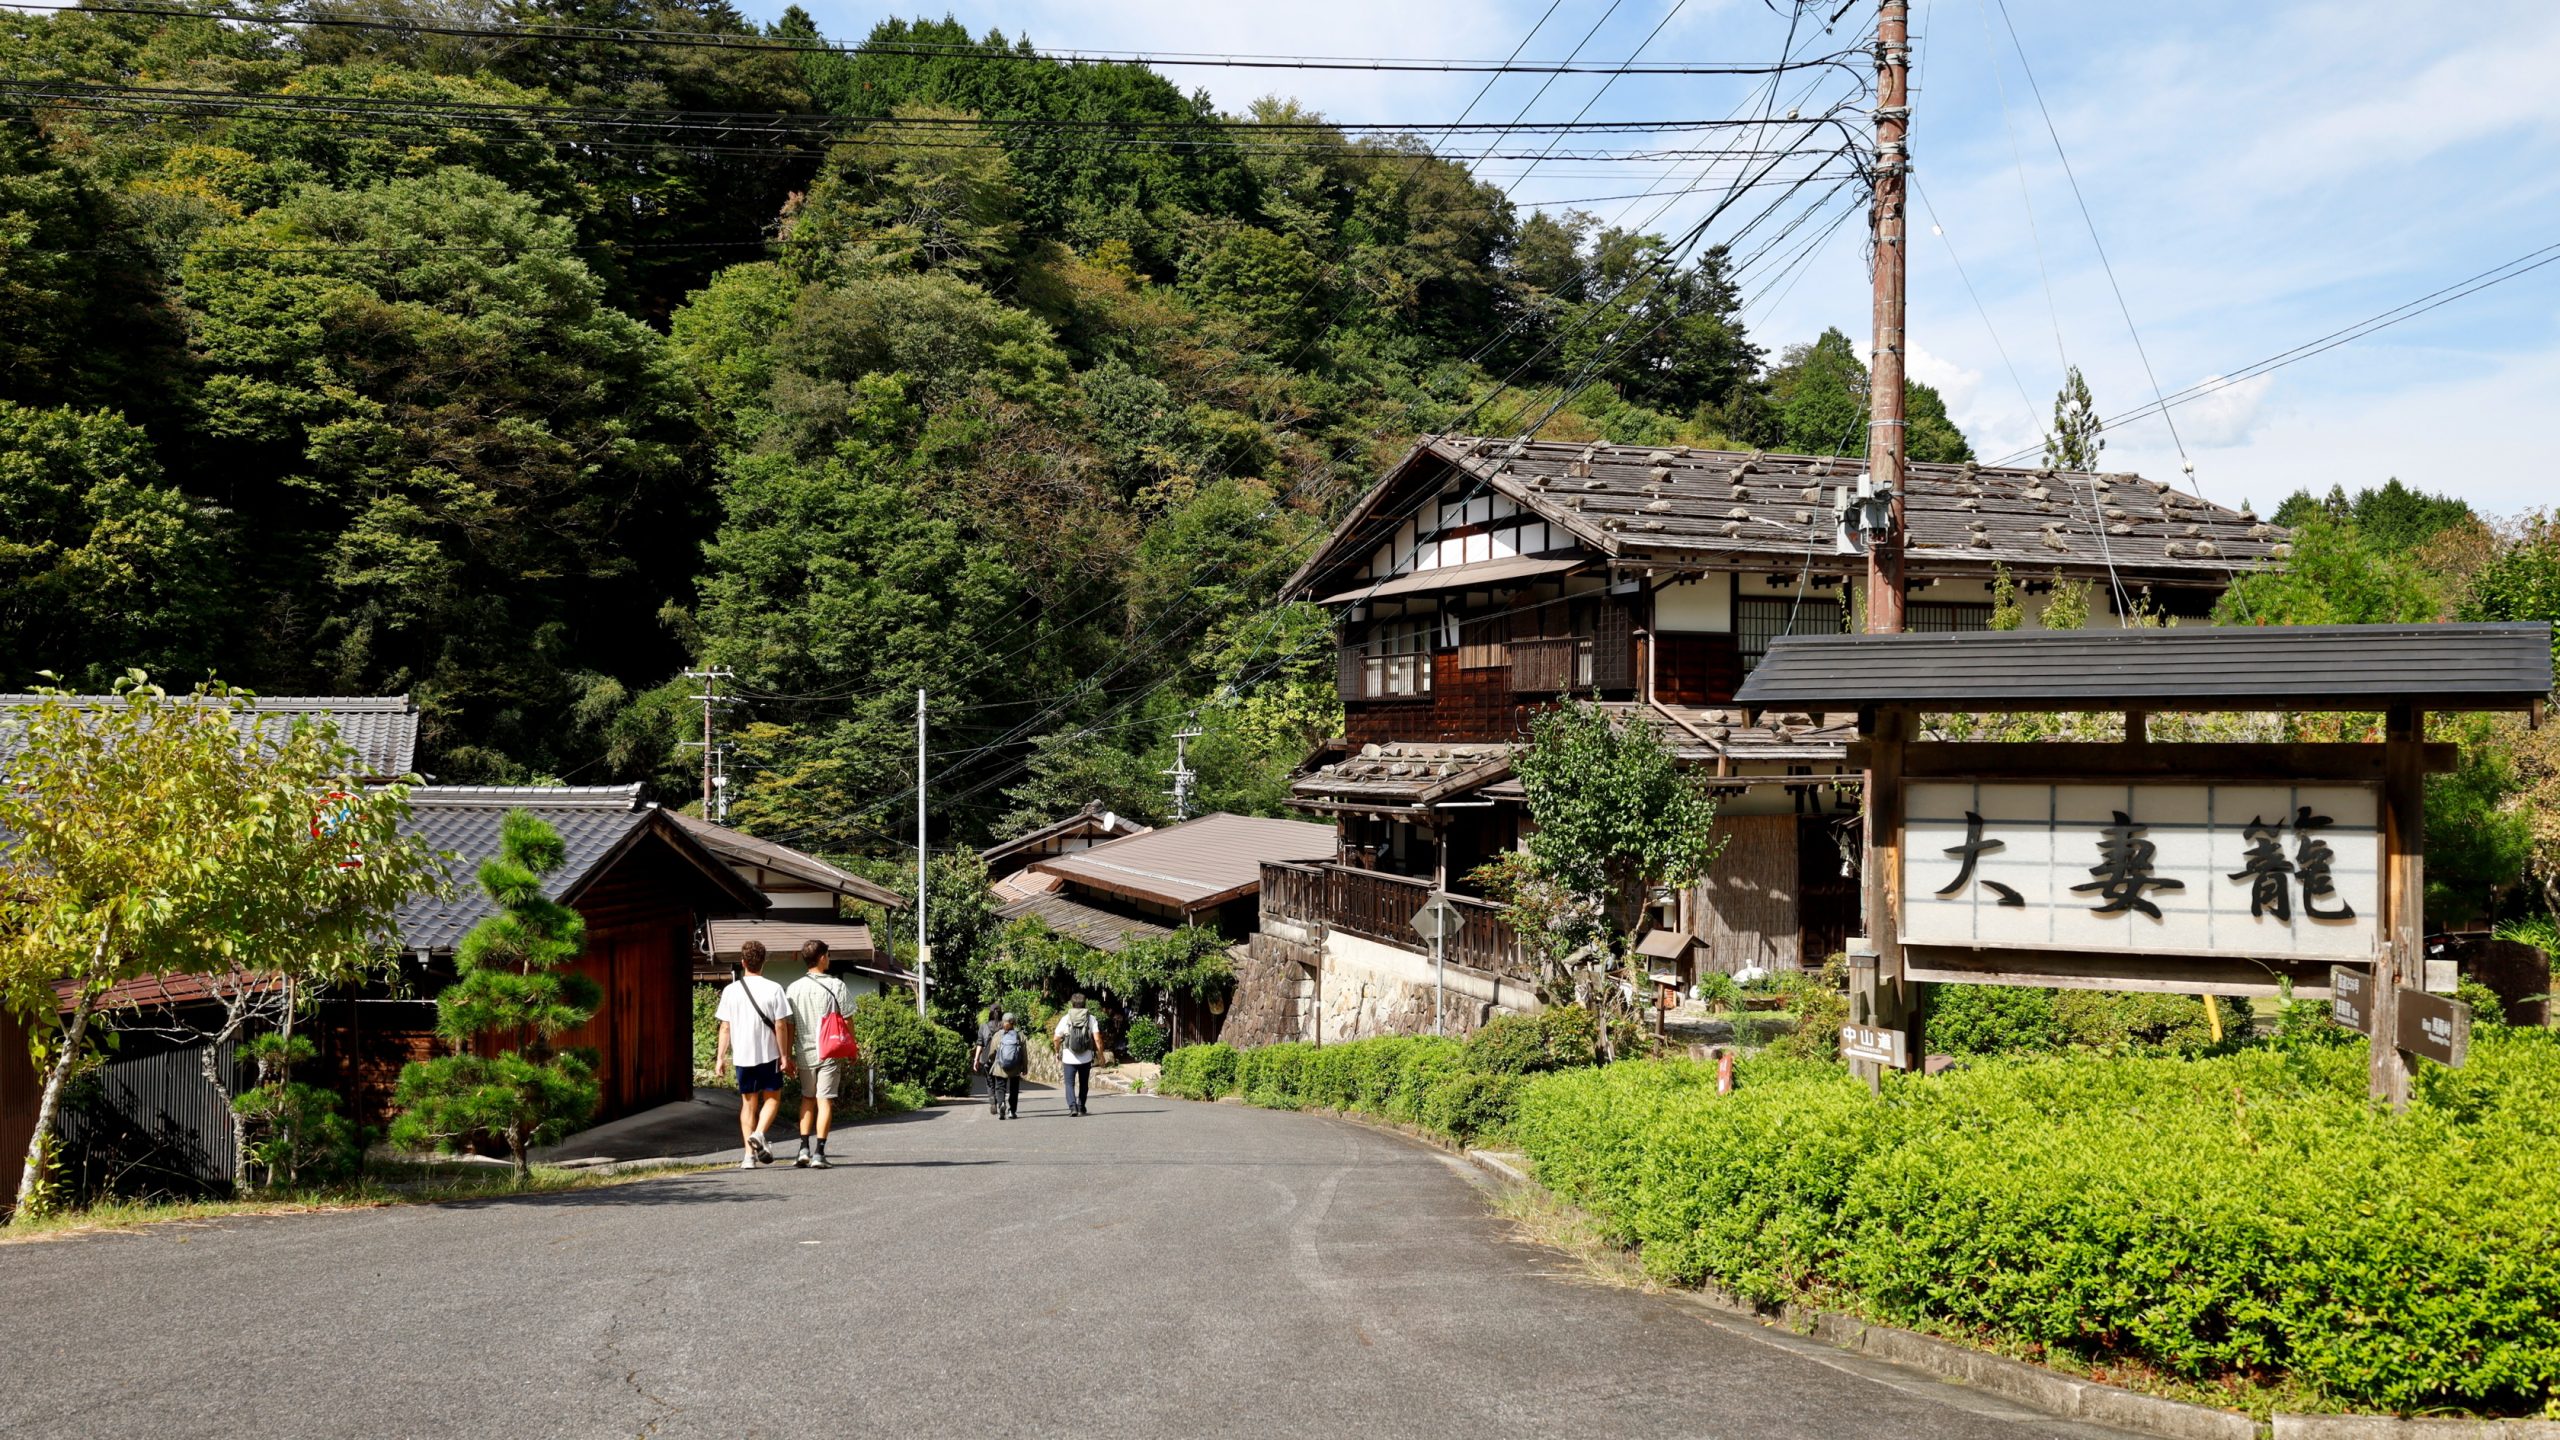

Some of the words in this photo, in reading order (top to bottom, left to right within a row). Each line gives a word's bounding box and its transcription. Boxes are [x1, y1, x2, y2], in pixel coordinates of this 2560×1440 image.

[1934, 805, 2357, 922] 大妻籠
[1843, 1026, 1892, 1050] 中山道
